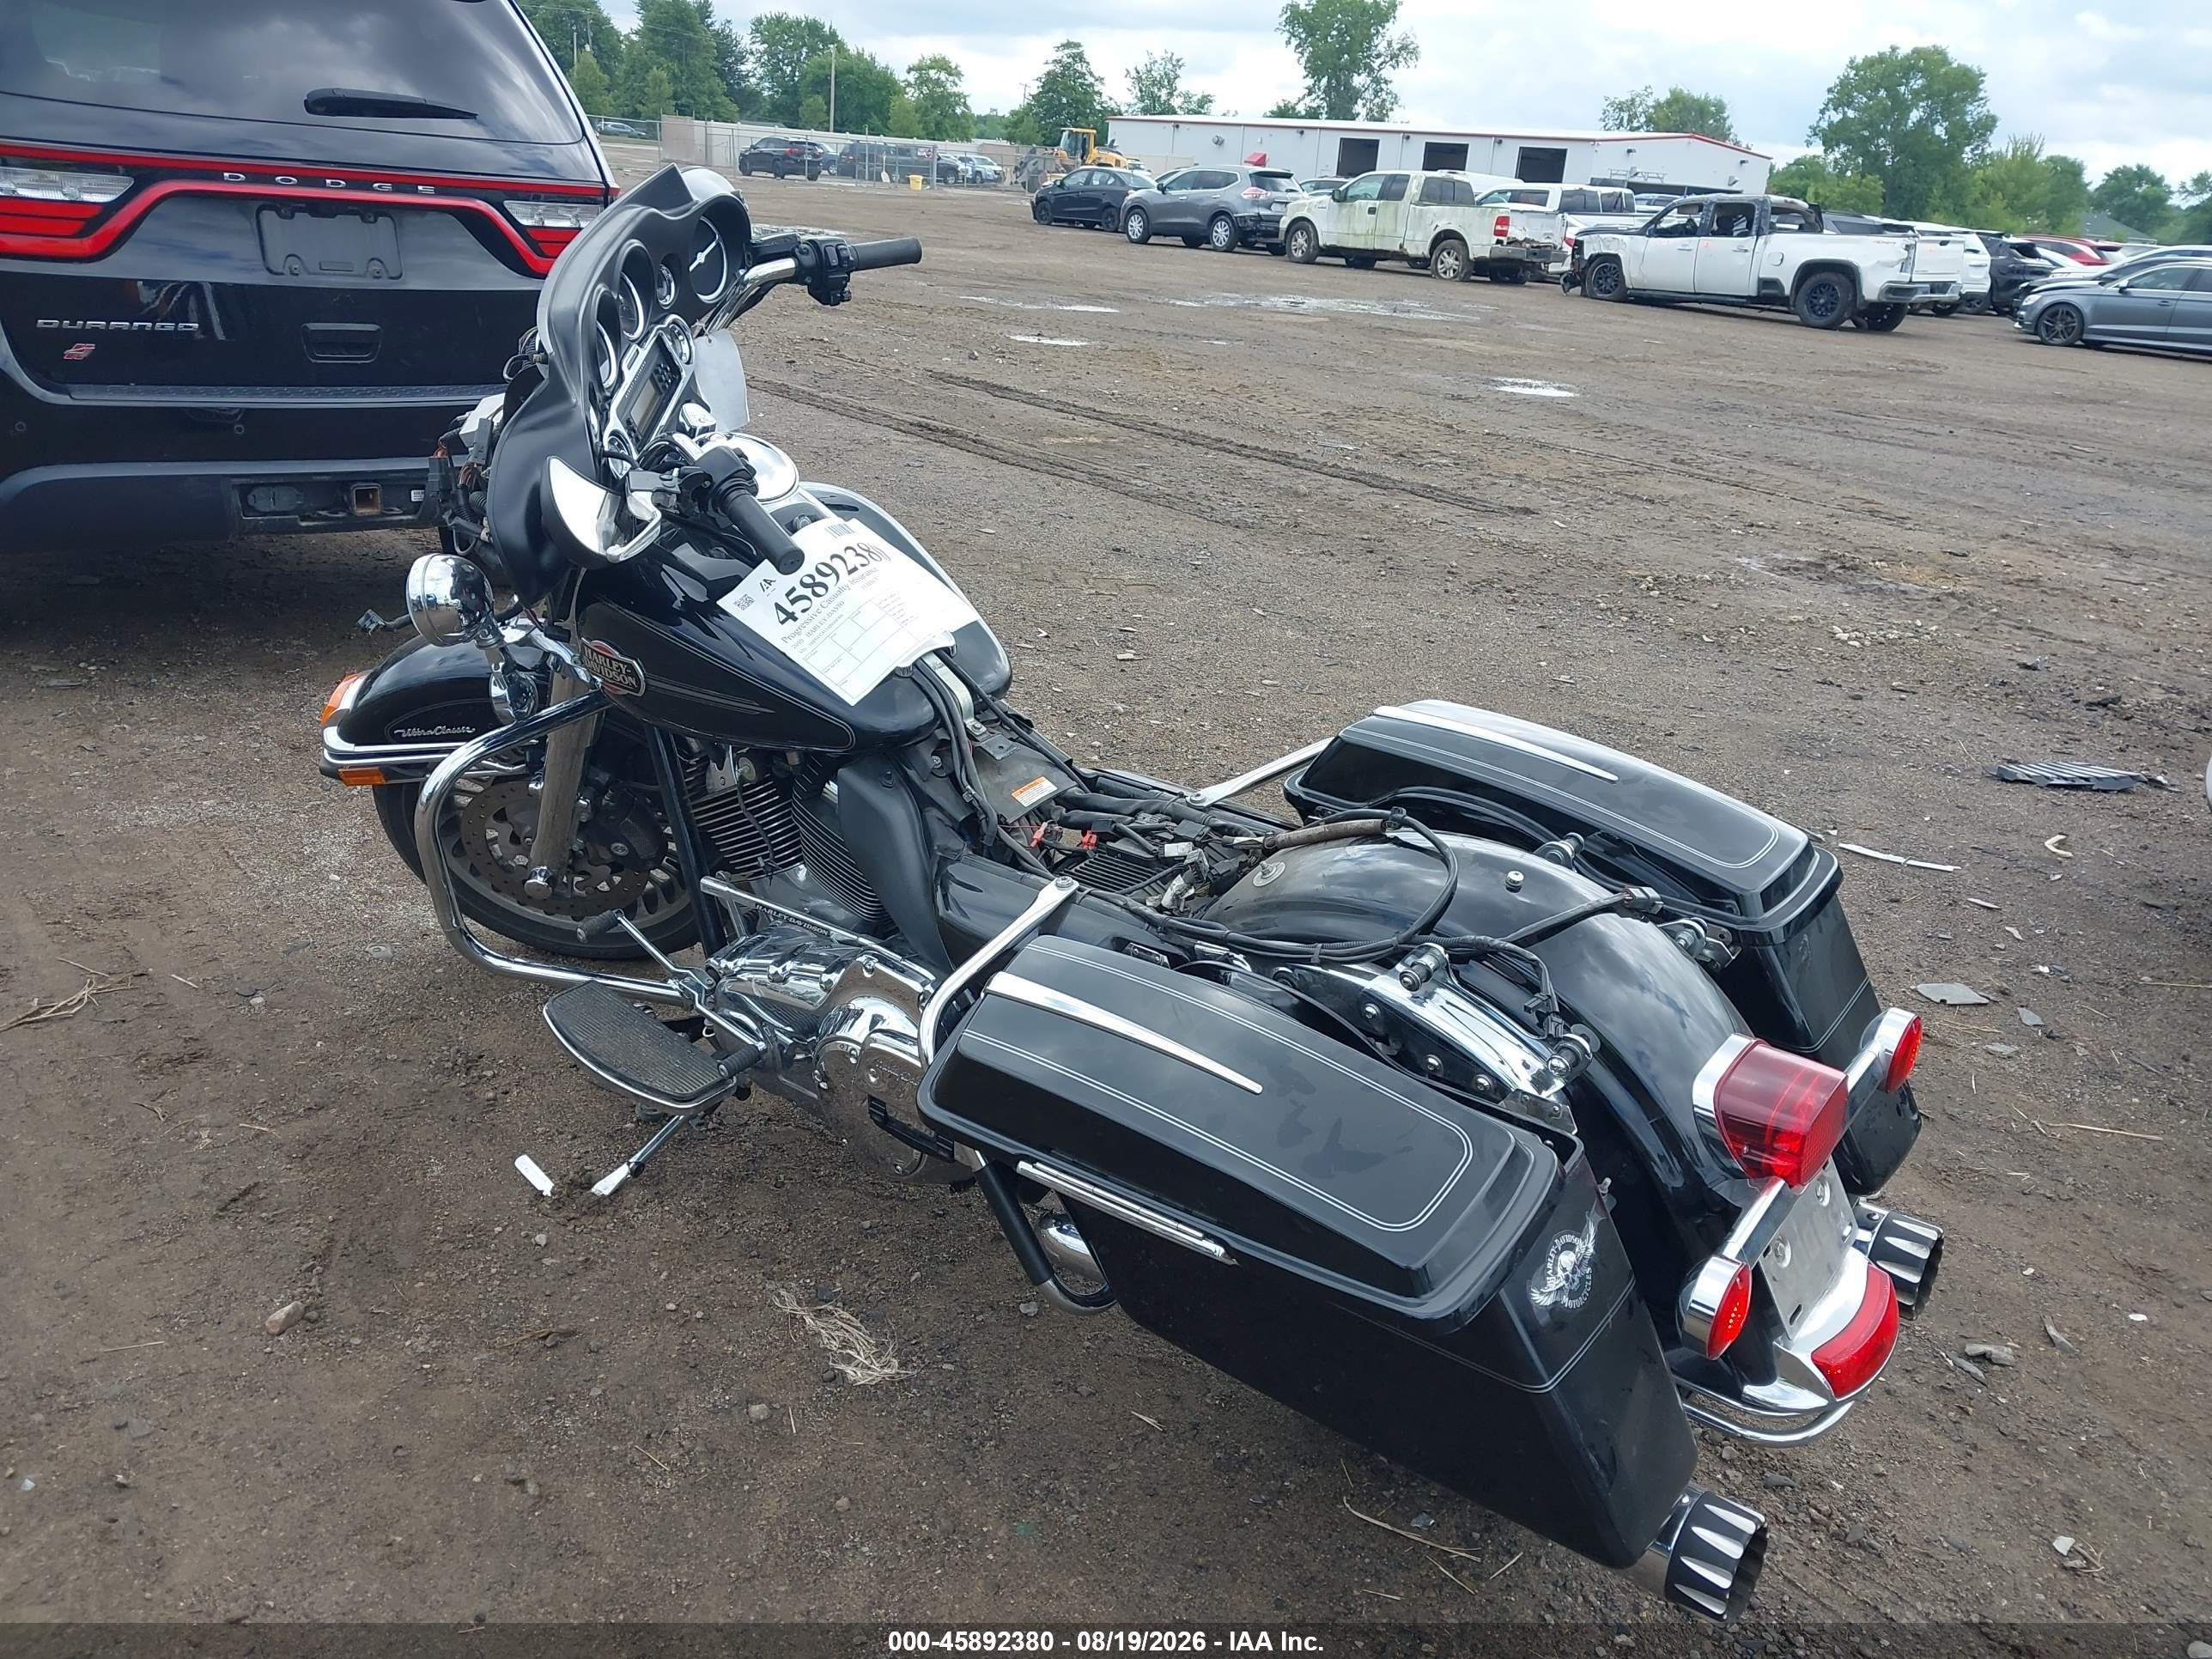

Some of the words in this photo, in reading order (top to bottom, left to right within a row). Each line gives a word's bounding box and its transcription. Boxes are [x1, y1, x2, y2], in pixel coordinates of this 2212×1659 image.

[222, 172, 435, 194] DODGE
[36, 319, 199, 331] DURANGO
[781, 607, 822, 643] Progressive
[820, 582, 851, 608] Casualty
[584, 646, 632, 674] HARLEY-
[584, 656, 637, 688] DAVIDSON
[756, 904, 829, 936] HARLEY-DAVIDSON
[1561, 1267, 1593, 1310] MOTORCYCLES
